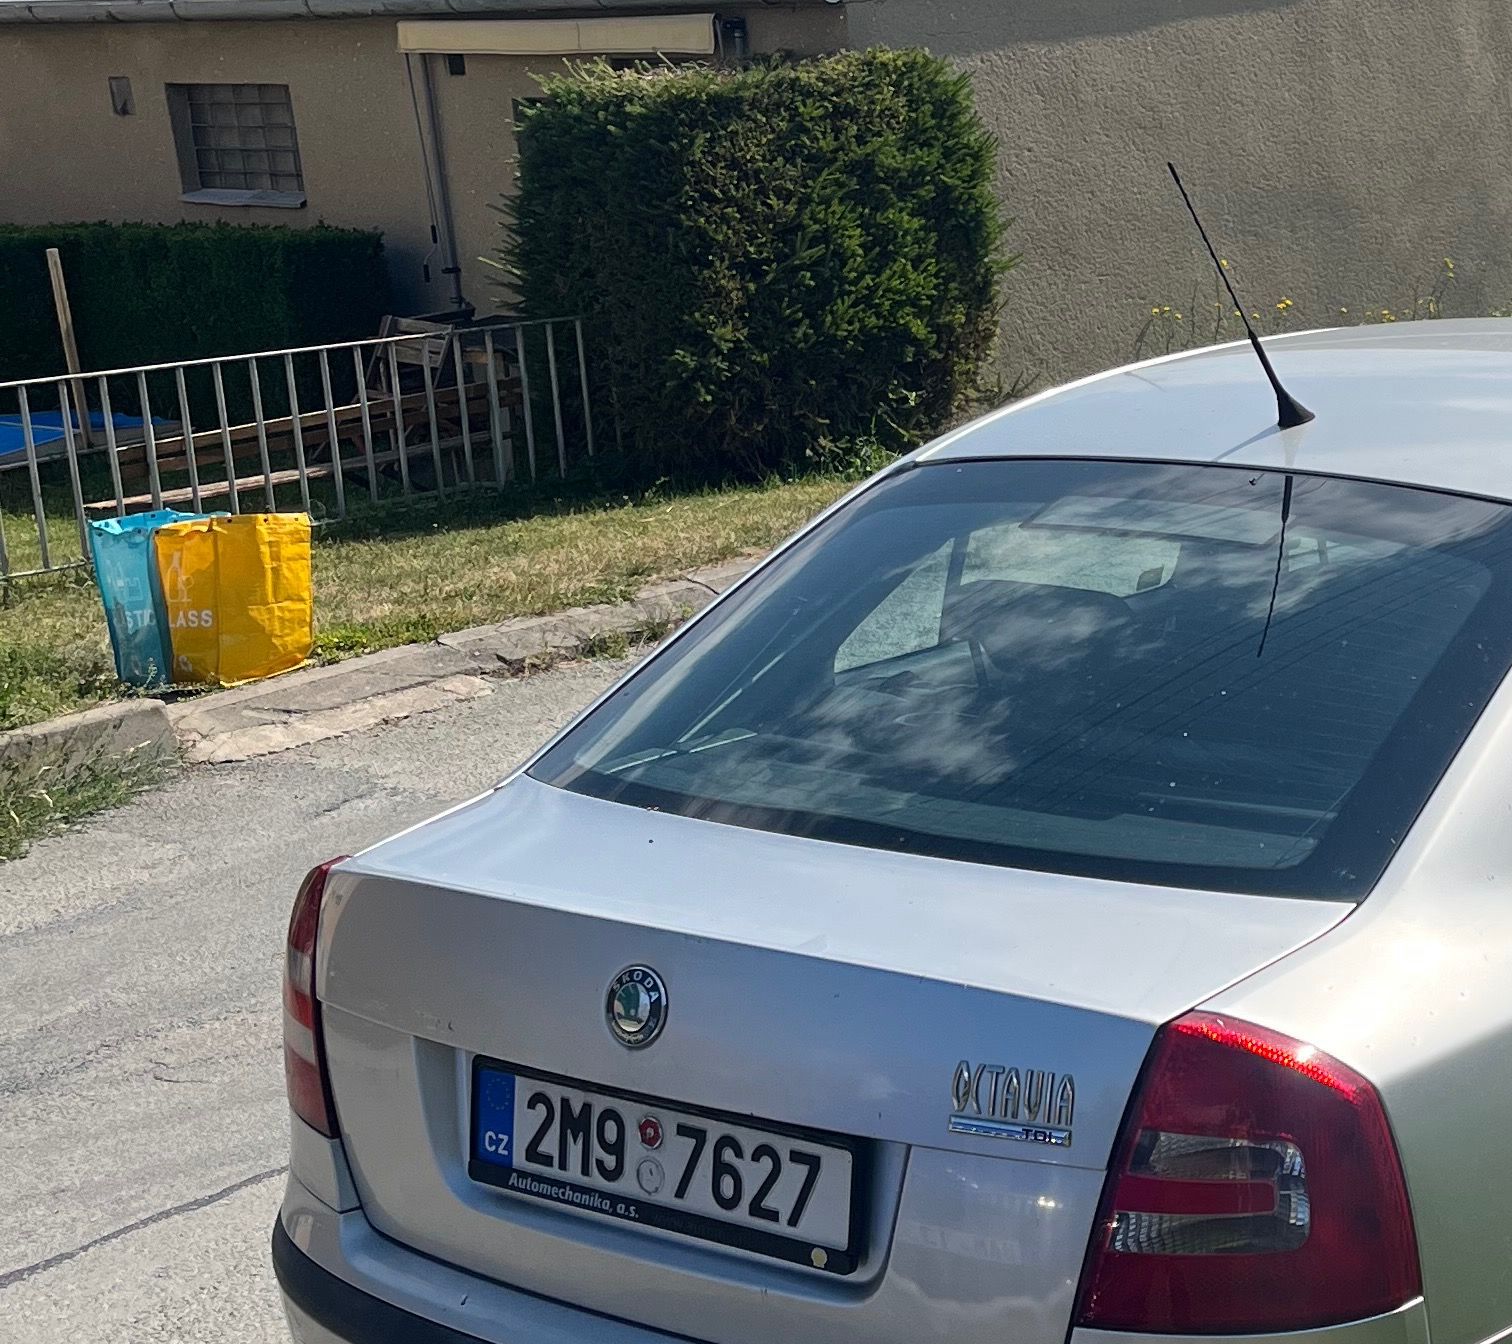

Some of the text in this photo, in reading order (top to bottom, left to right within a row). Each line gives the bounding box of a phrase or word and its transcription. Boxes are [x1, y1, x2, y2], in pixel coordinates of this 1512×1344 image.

[168, 609, 213, 627] LASS
[951, 1060, 1075, 1126] OCTAVIA
[484, 1131, 509, 1156] CZ
[525, 1091, 822, 1228] 2M9 7627
[508, 1172, 639, 1218] Automechanika, a.s.
